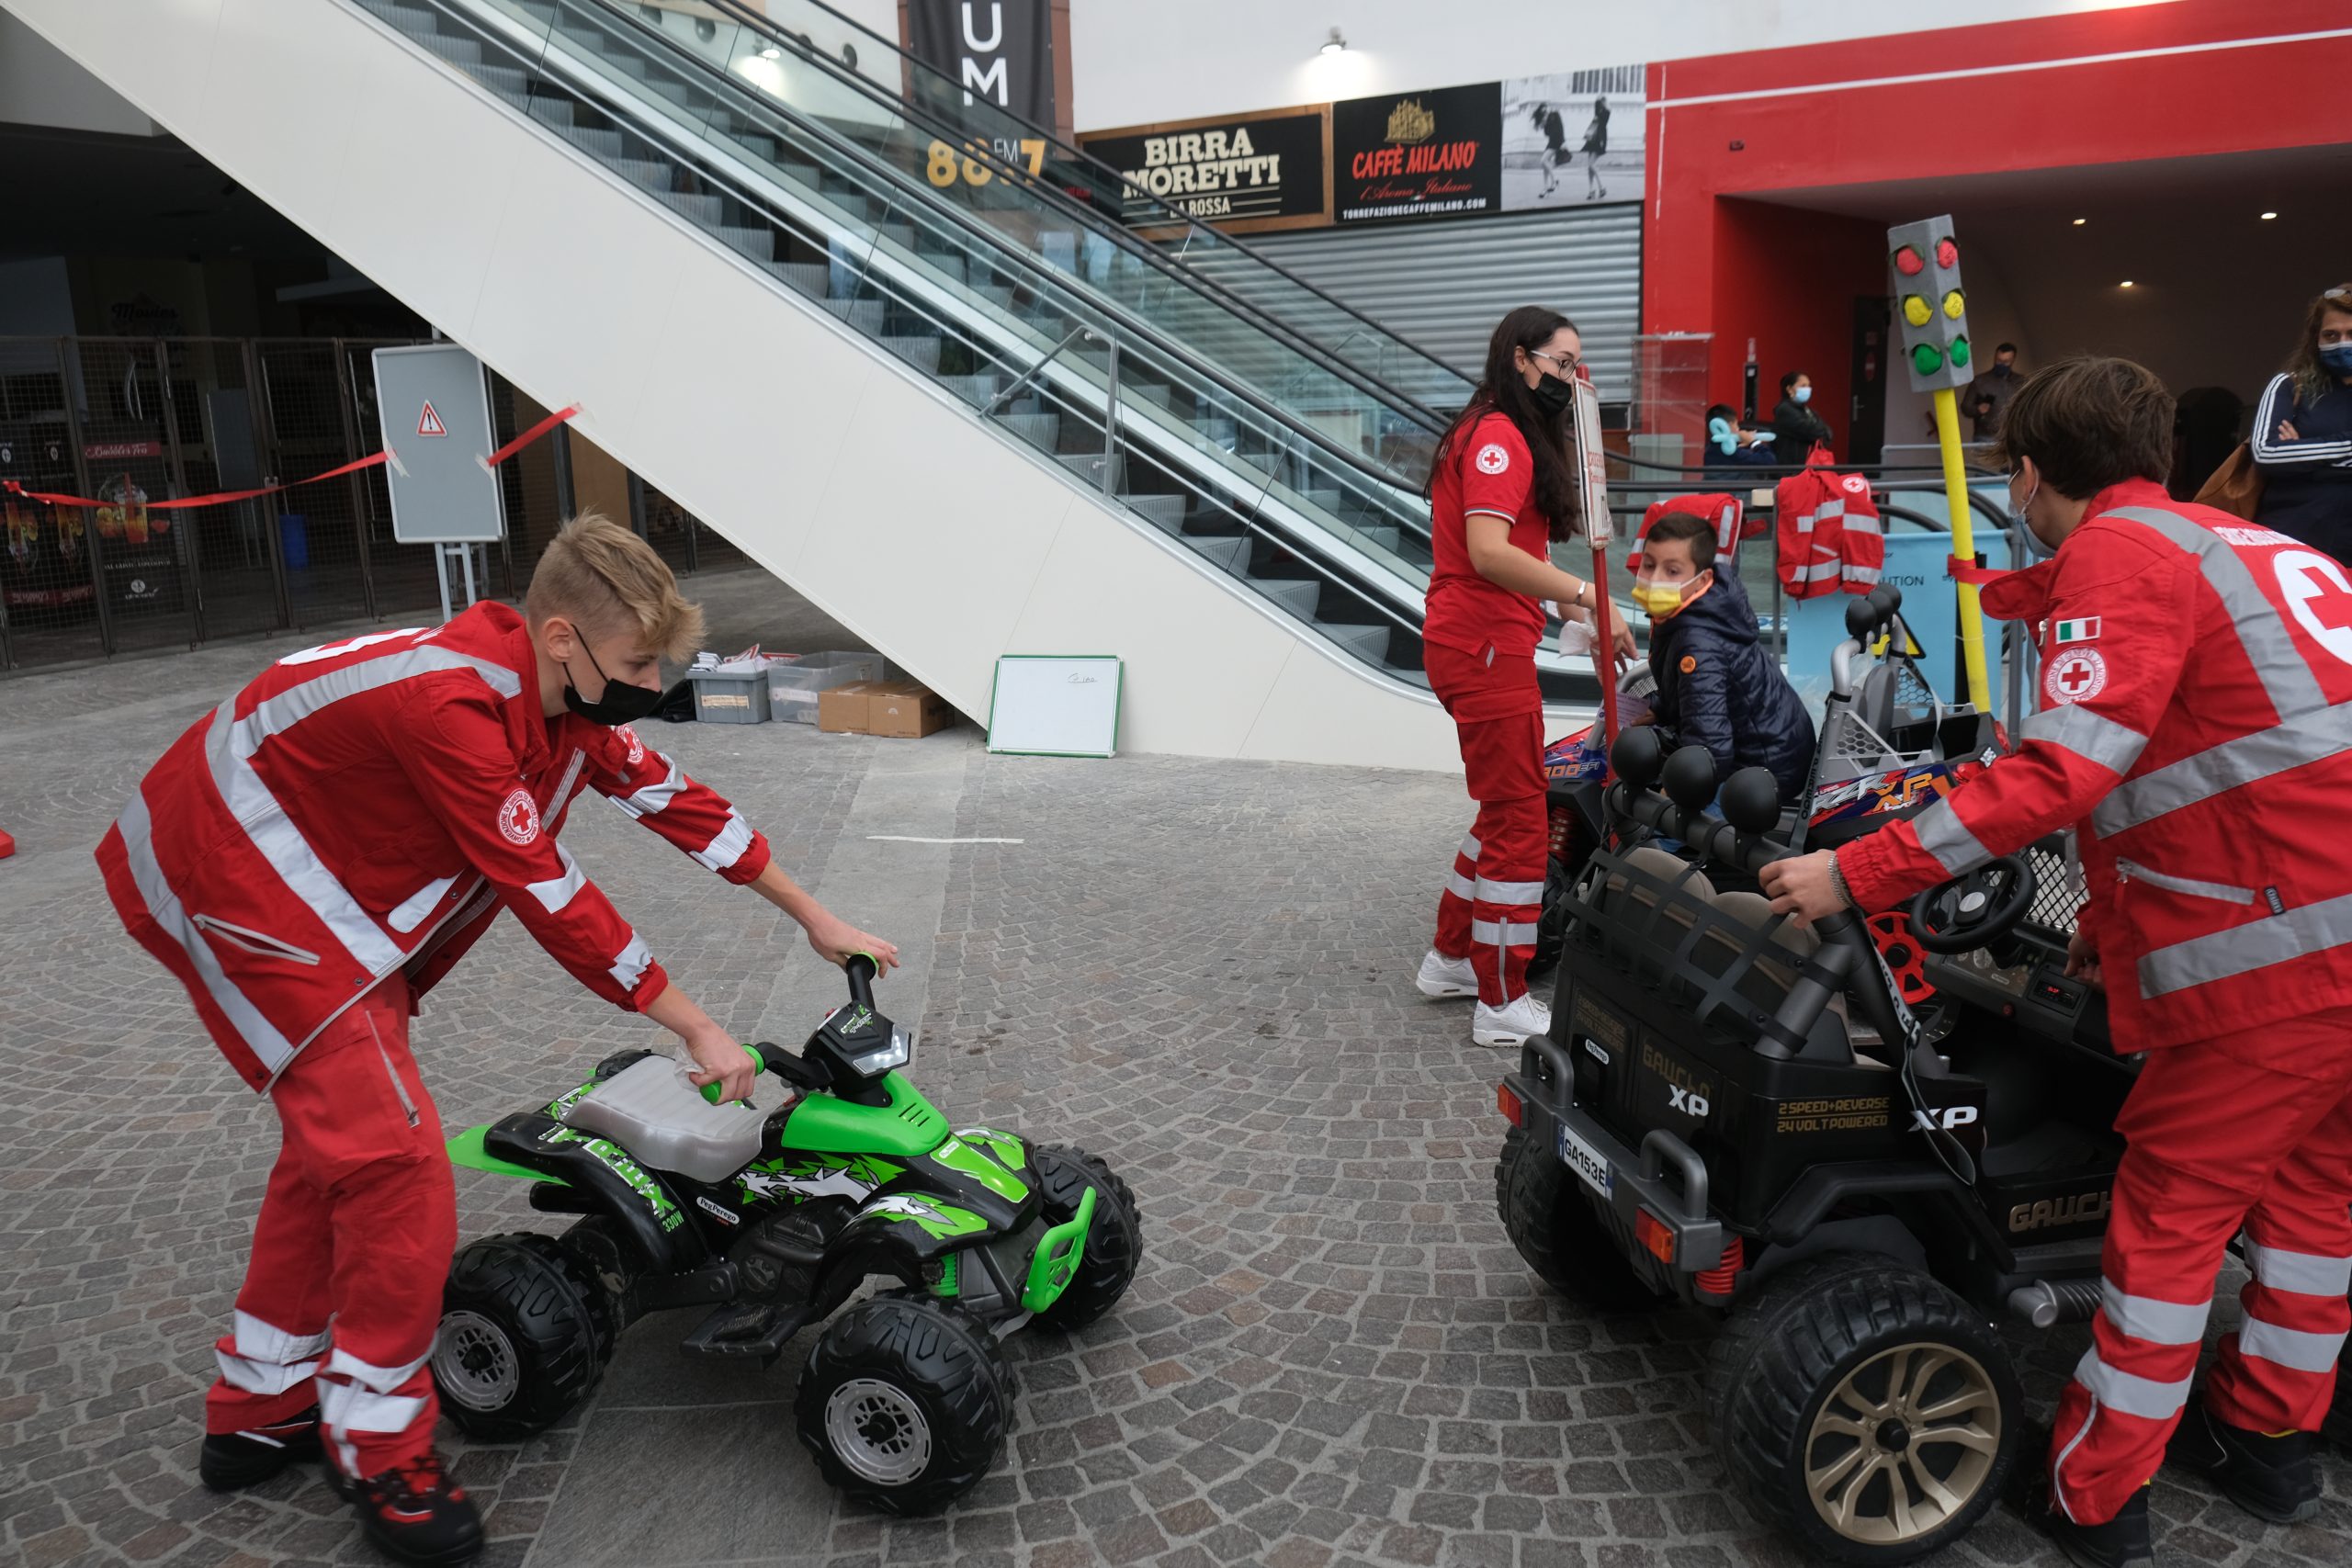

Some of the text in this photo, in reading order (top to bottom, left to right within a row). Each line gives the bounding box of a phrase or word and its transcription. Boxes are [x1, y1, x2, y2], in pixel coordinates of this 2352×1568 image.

[1145, 128, 1254, 167] BIRRA
[1351, 140, 1476, 180] CAFFÈ MILANO
[1122, 154, 1281, 199] MORETTI
[1189, 198, 1231, 215] ROSSA
[1668, 1084, 1709, 1117] XP
[1908, 1105, 1978, 1133] XP
[1565, 1138, 1606, 1188] GA153E
[662, 1210, 684, 1233] 330W
[700, 1197, 737, 1222] PegPerego
[2008, 1190, 2112, 1233] GAUCH
